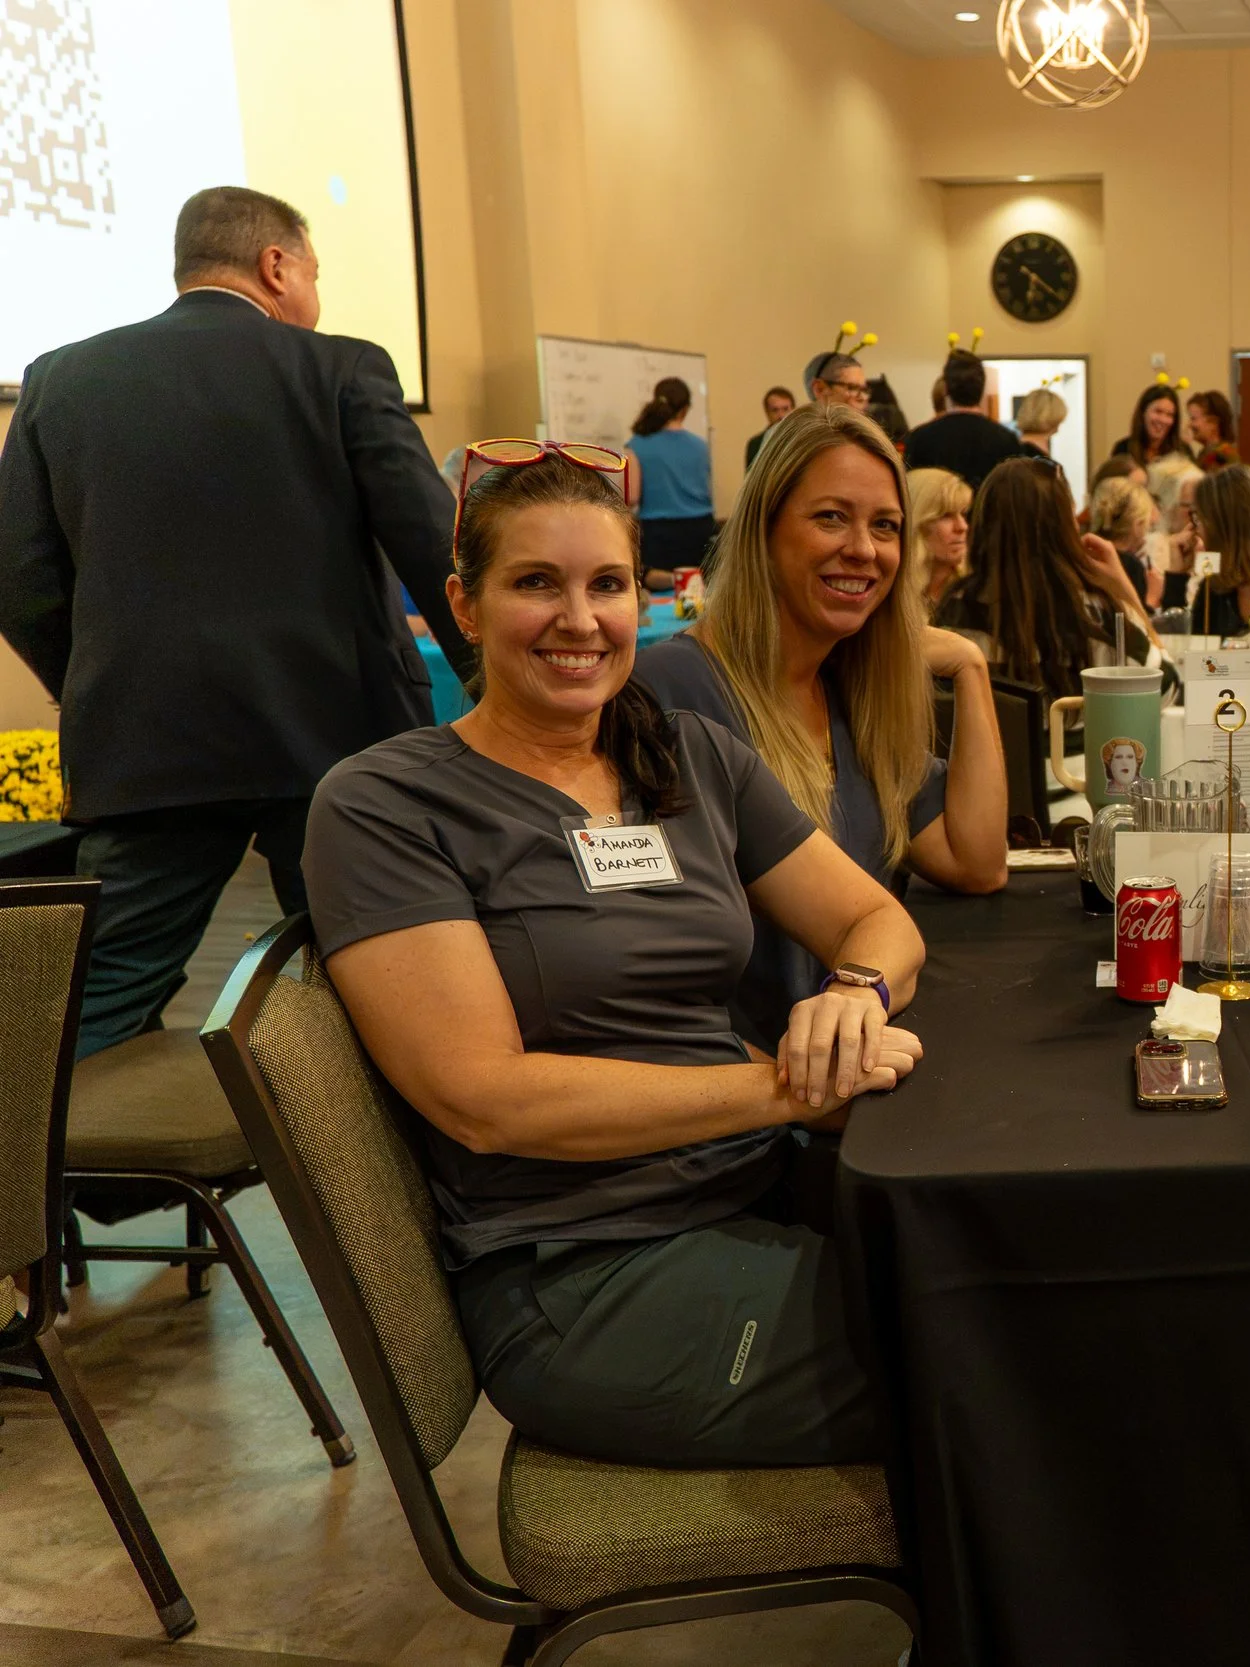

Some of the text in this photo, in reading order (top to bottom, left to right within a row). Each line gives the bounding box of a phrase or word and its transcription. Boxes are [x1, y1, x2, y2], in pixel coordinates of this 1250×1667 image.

[1218, 688, 1235, 715] 2
[601, 837, 654, 852] AMANDA
[593, 856, 664, 873] BARNETT
